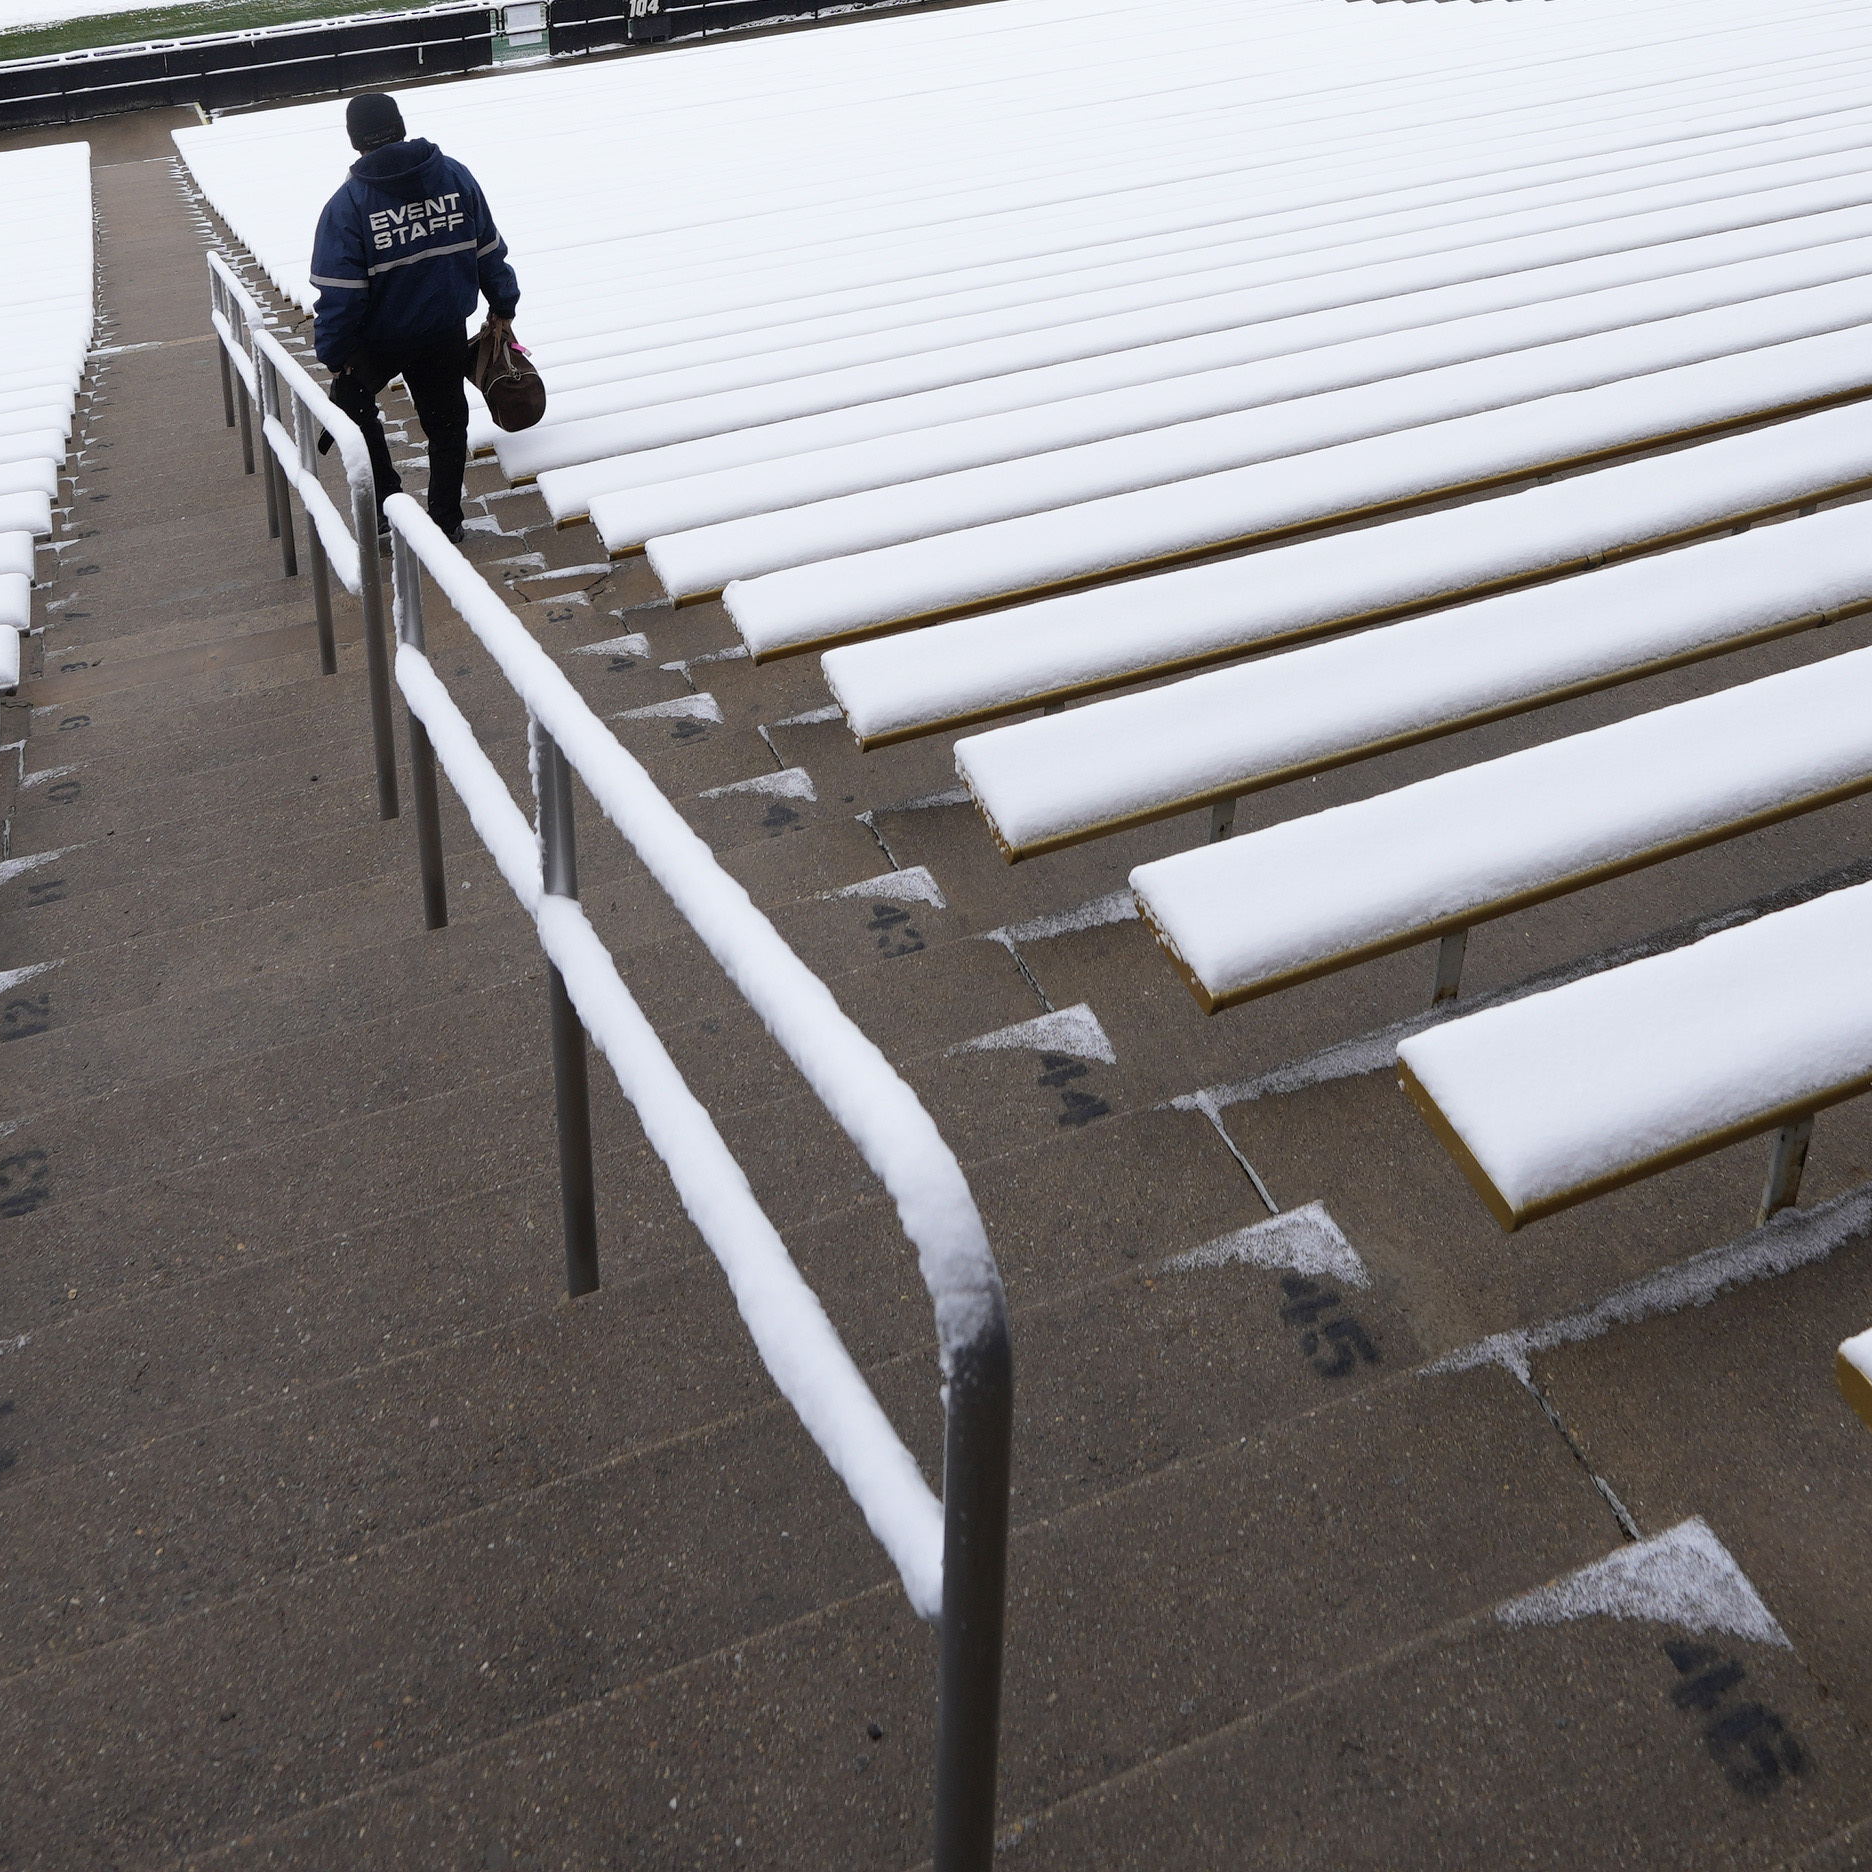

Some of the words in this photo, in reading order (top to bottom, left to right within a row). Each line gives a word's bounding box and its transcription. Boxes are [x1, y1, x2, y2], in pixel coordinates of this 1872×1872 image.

[369, 192, 460, 231] EVENT
[373, 212, 464, 250] STAFF
[1038, 1052, 1111, 1127] 44
[1278, 1274, 1382, 1377] 45
[1663, 1637, 1814, 1796] 46
